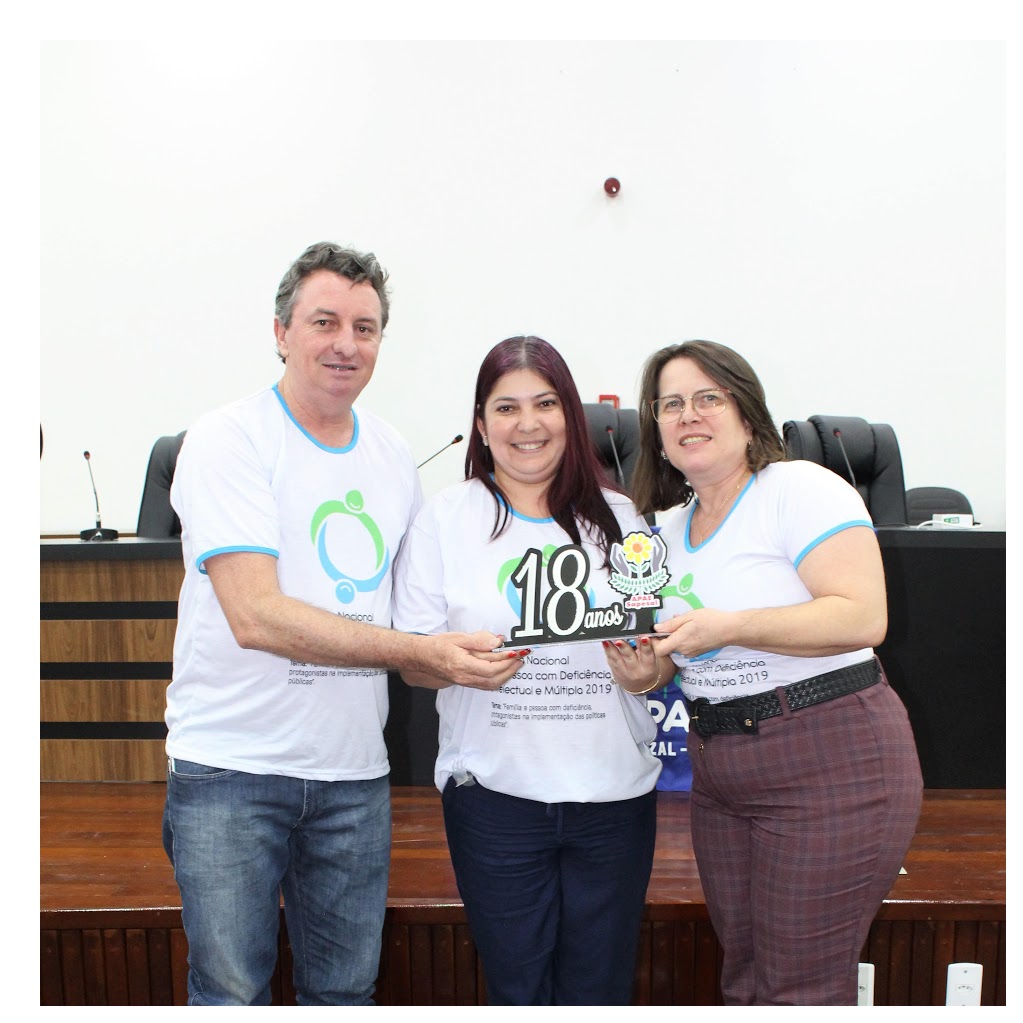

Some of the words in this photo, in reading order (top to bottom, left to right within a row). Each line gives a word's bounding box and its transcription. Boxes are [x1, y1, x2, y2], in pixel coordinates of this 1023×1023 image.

[514, 549, 586, 638] 18
[584, 605, 624, 629] anos
[338, 611, 374, 622] Nacional
[526, 656, 570, 665] Nacional
[715, 660, 766, 672] Deficiência
[535, 672, 557, 680] com
[560, 669, 611, 680] Deficiência
[738, 670, 768, 684] 2019
[497, 685, 533, 695] electual
[535, 687, 542, 695] e
[544, 685, 583, 697] Múltipla
[585, 684, 612, 694] 2019
[647, 700, 690, 732] PA
